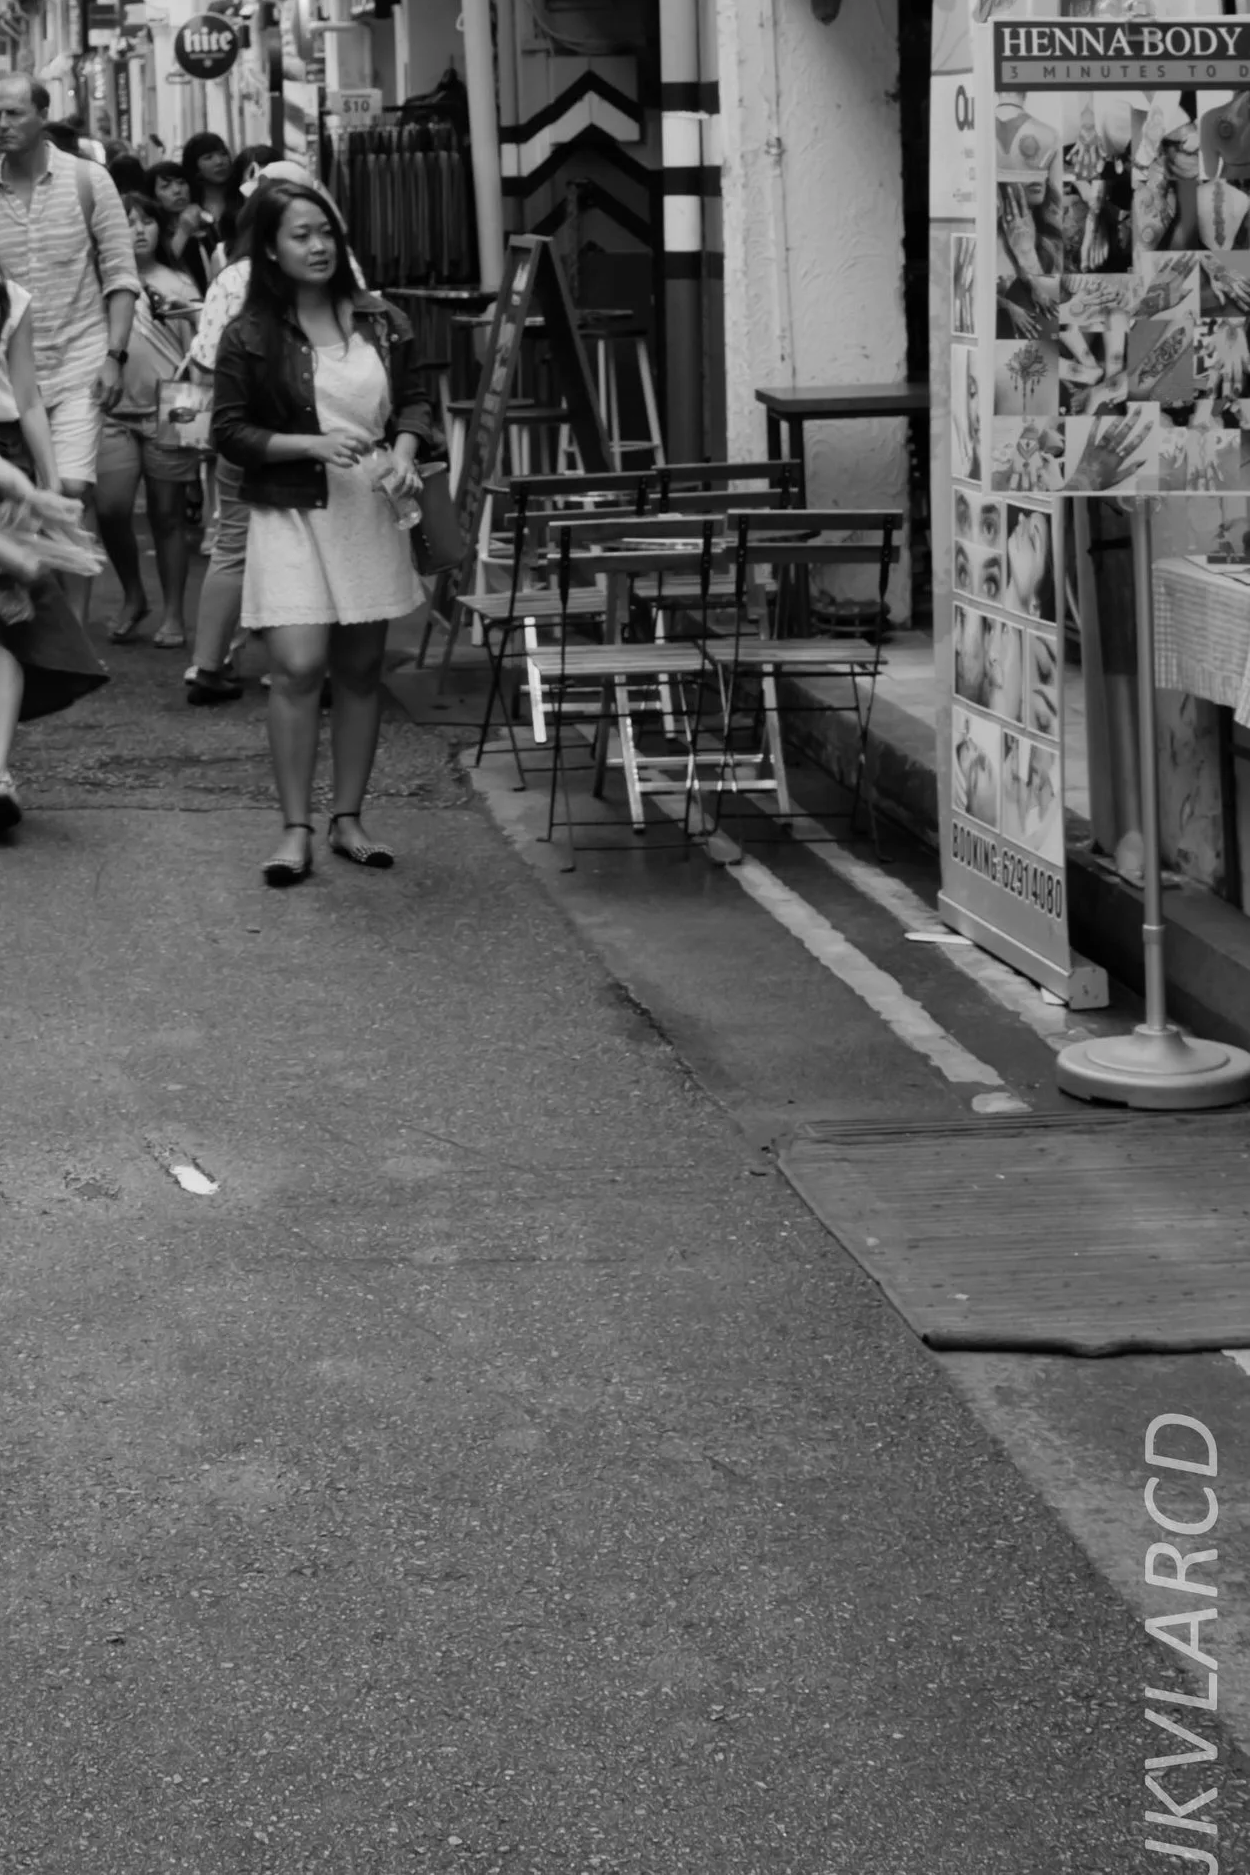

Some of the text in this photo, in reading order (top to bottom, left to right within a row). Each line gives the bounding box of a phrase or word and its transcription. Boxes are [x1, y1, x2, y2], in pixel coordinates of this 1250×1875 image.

[183, 26, 234, 53] hite
[1001, 27, 1243, 57] HENNA BODY
[1009, 65, 1019, 80] 3
[1043, 65, 1166, 79] MINUTES
[1188, 64, 1217, 78] TO
[343, 99, 370, 113] $10
